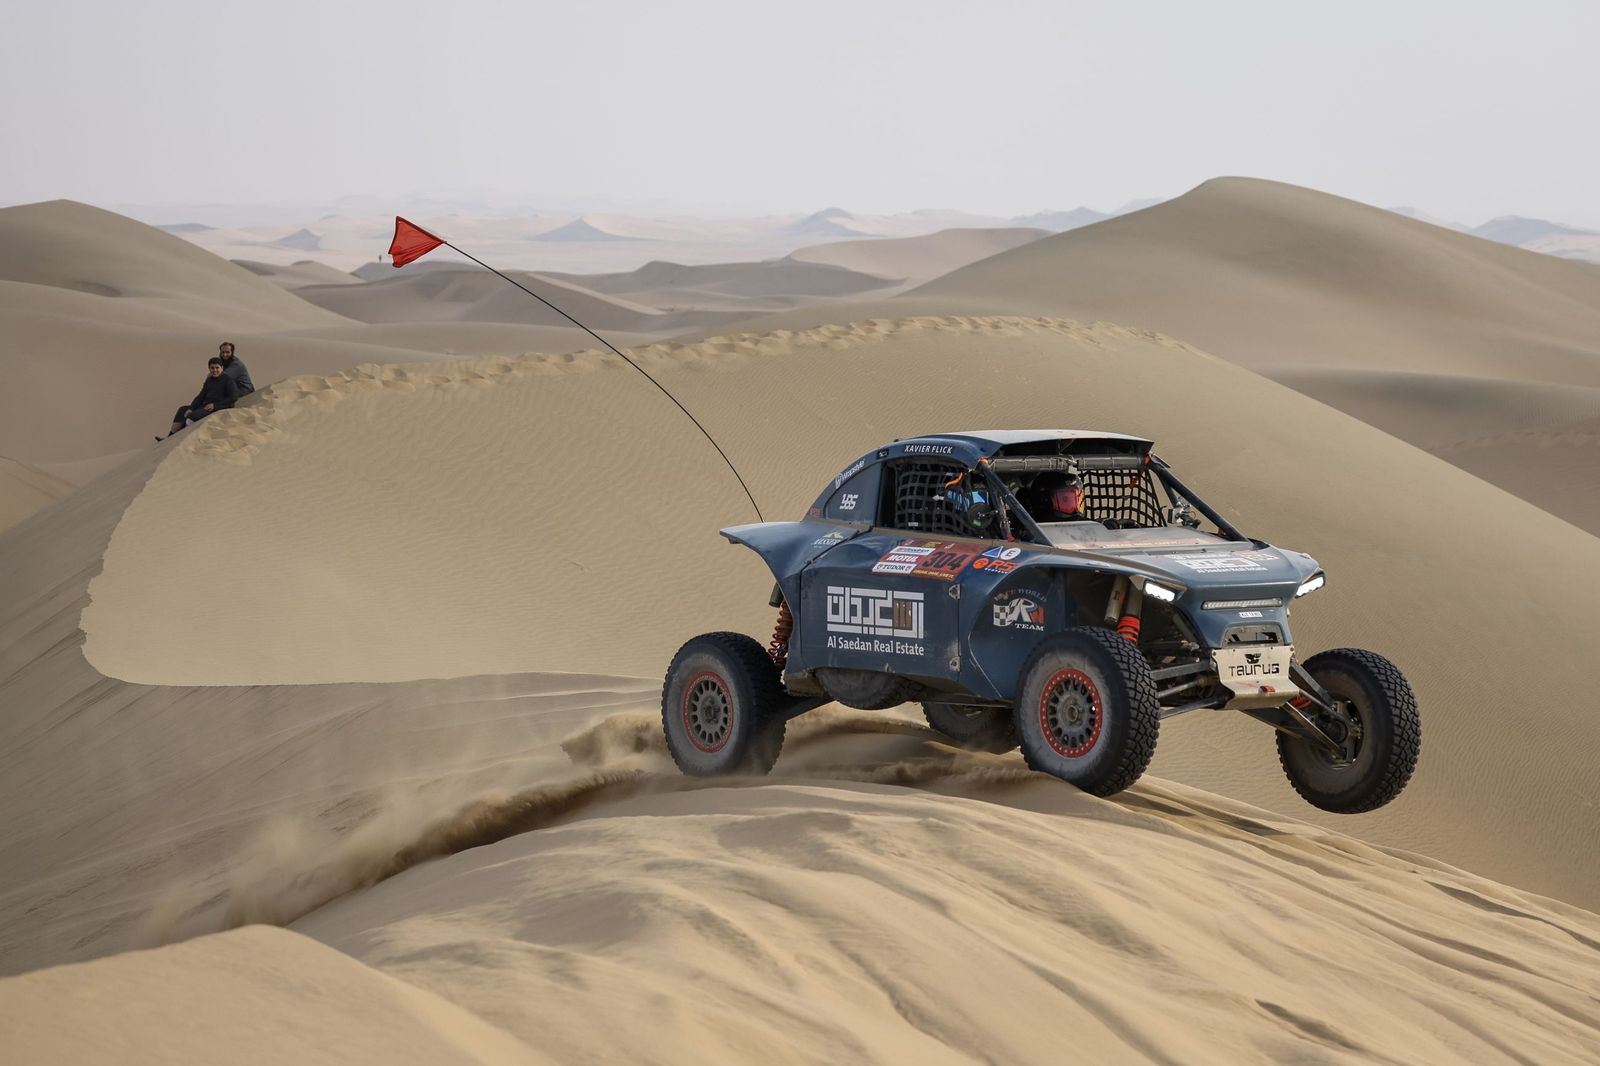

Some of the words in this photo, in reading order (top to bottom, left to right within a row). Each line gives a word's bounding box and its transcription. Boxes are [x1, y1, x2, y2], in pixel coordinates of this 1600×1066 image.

[904, 444, 931, 453] XAVIER
[931, 445, 953, 454] FLICK
[886, 554, 920, 563] MOTUL
[921, 551, 970, 571] 304
[882, 563, 906, 571] TUDOR
[1014, 622, 1045, 632] TEAM
[826, 635, 837, 649] Al
[838, 636, 872, 652] Saedan
[873, 639, 894, 653] Real
[895, 641, 925, 656] Estate
